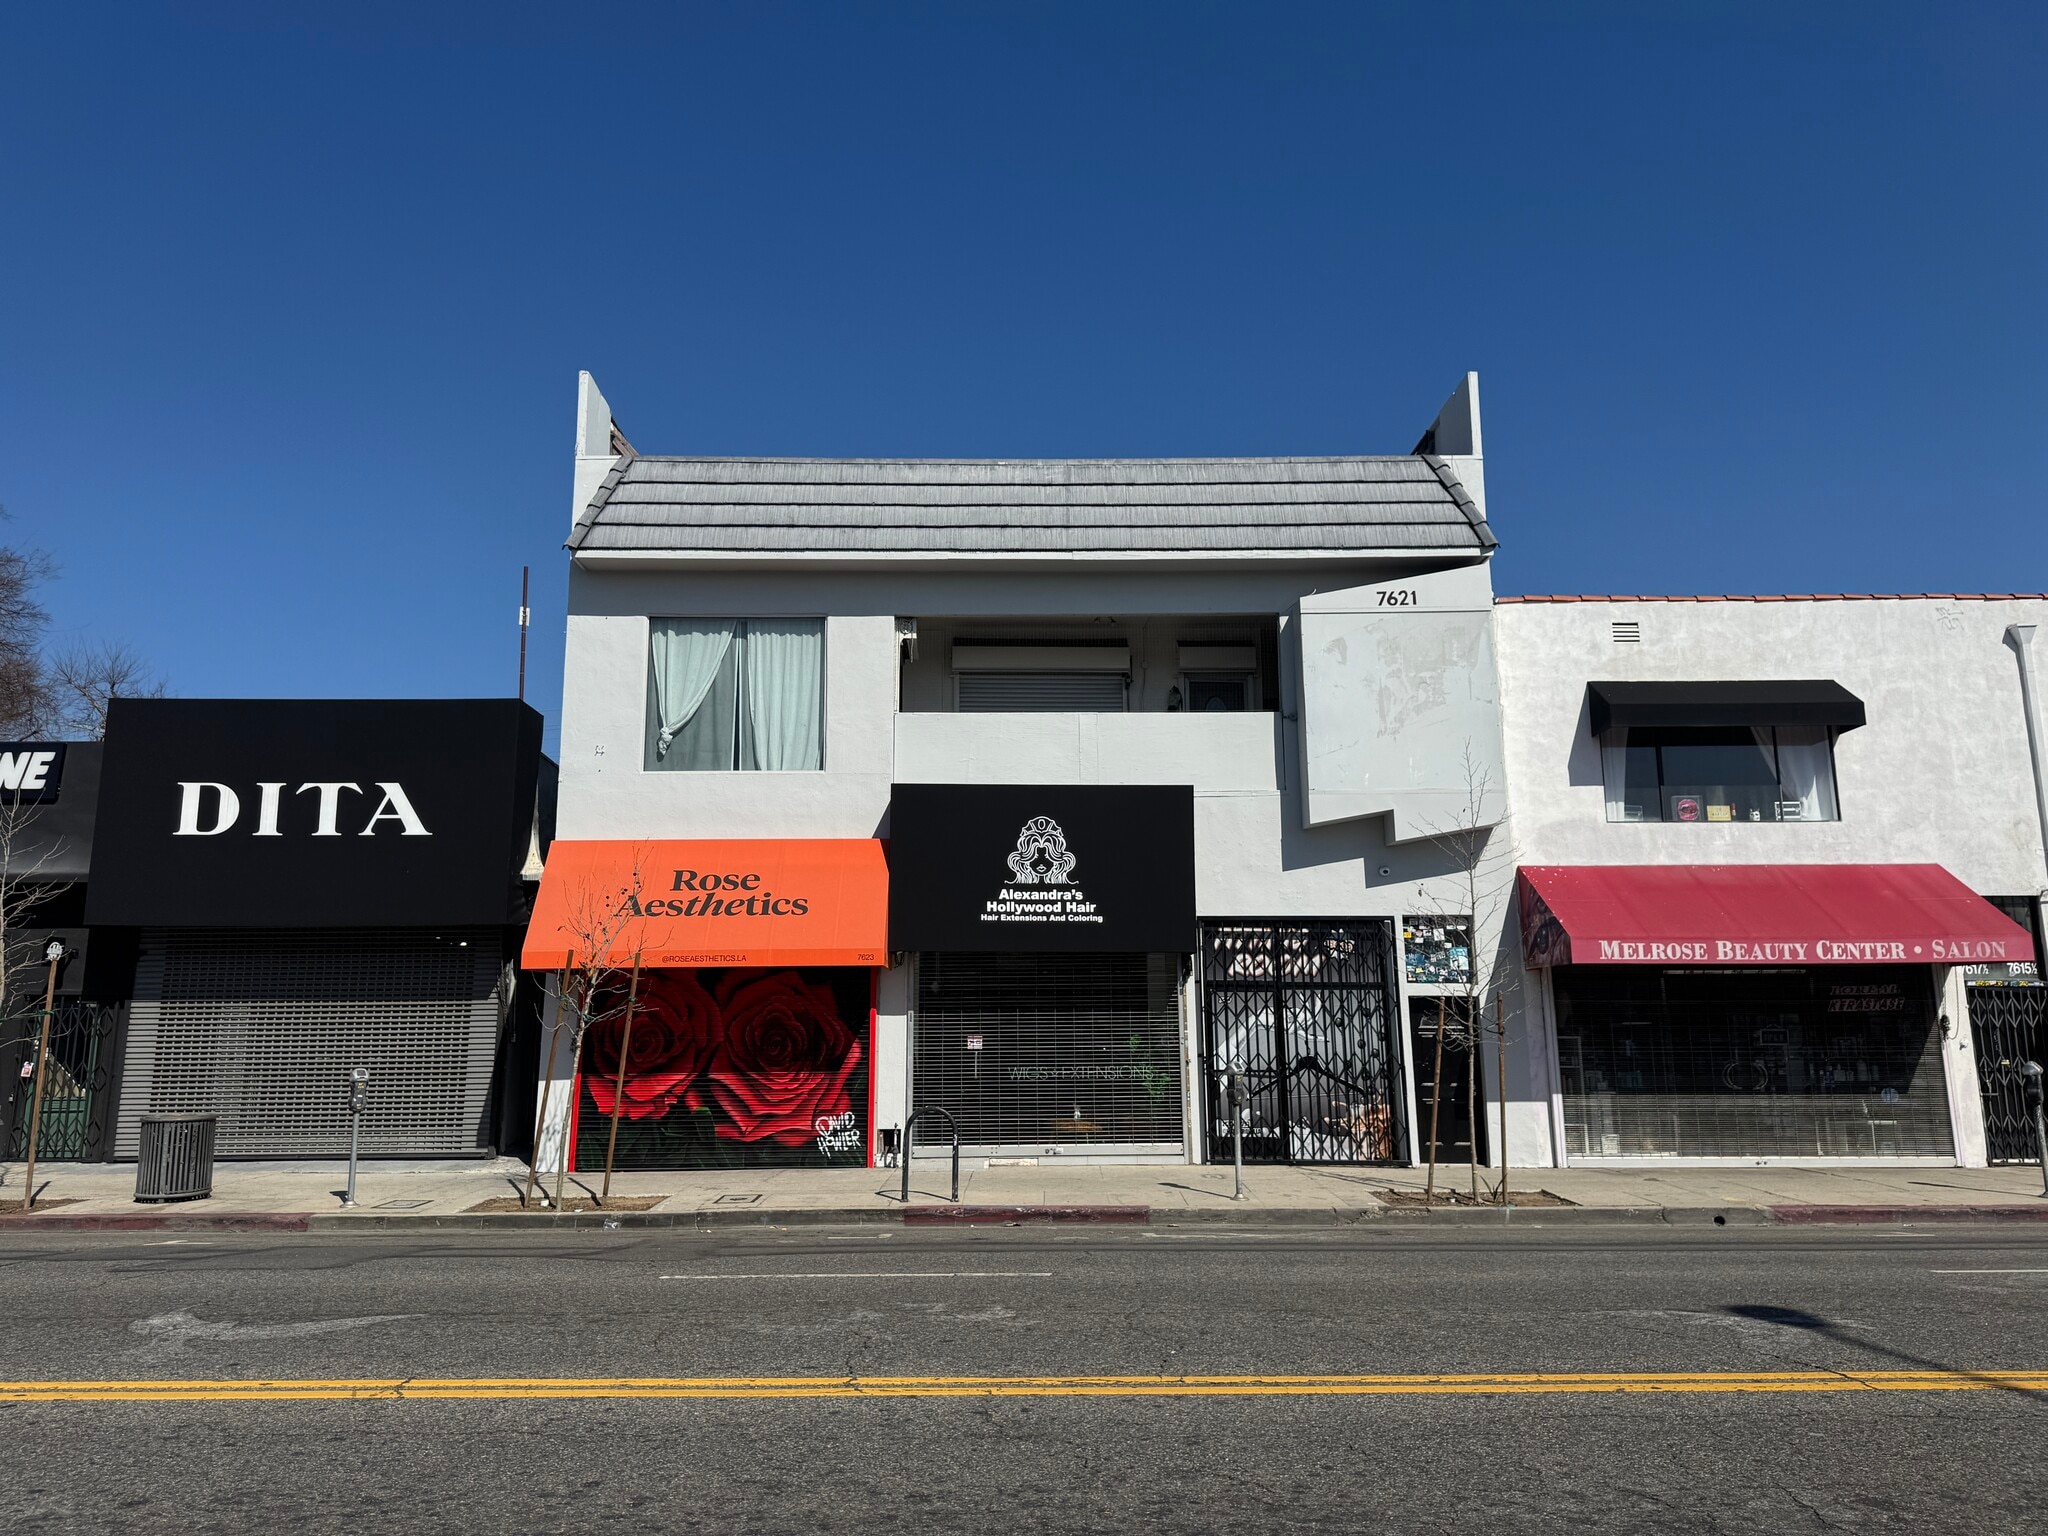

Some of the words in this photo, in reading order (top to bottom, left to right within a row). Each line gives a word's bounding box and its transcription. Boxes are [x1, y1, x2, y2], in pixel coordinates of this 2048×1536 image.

[1376, 590, 1417, 606] 7621
[0, 752, 56, 790] NE
[172, 782, 433, 836] DITA
[669, 869, 761, 892] Rose
[998, 889, 1084, 900] Alexandra's
[613, 892, 809, 917] Aesthetics
[986, 901, 1062, 915] Hollywood
[1066, 901, 1096, 913] Hair
[1067, 914, 1103, 923] Coloring
[661, 954, 747, 964] @ROSEAESTHETICS.LA
[857, 953, 875, 961] 7623
